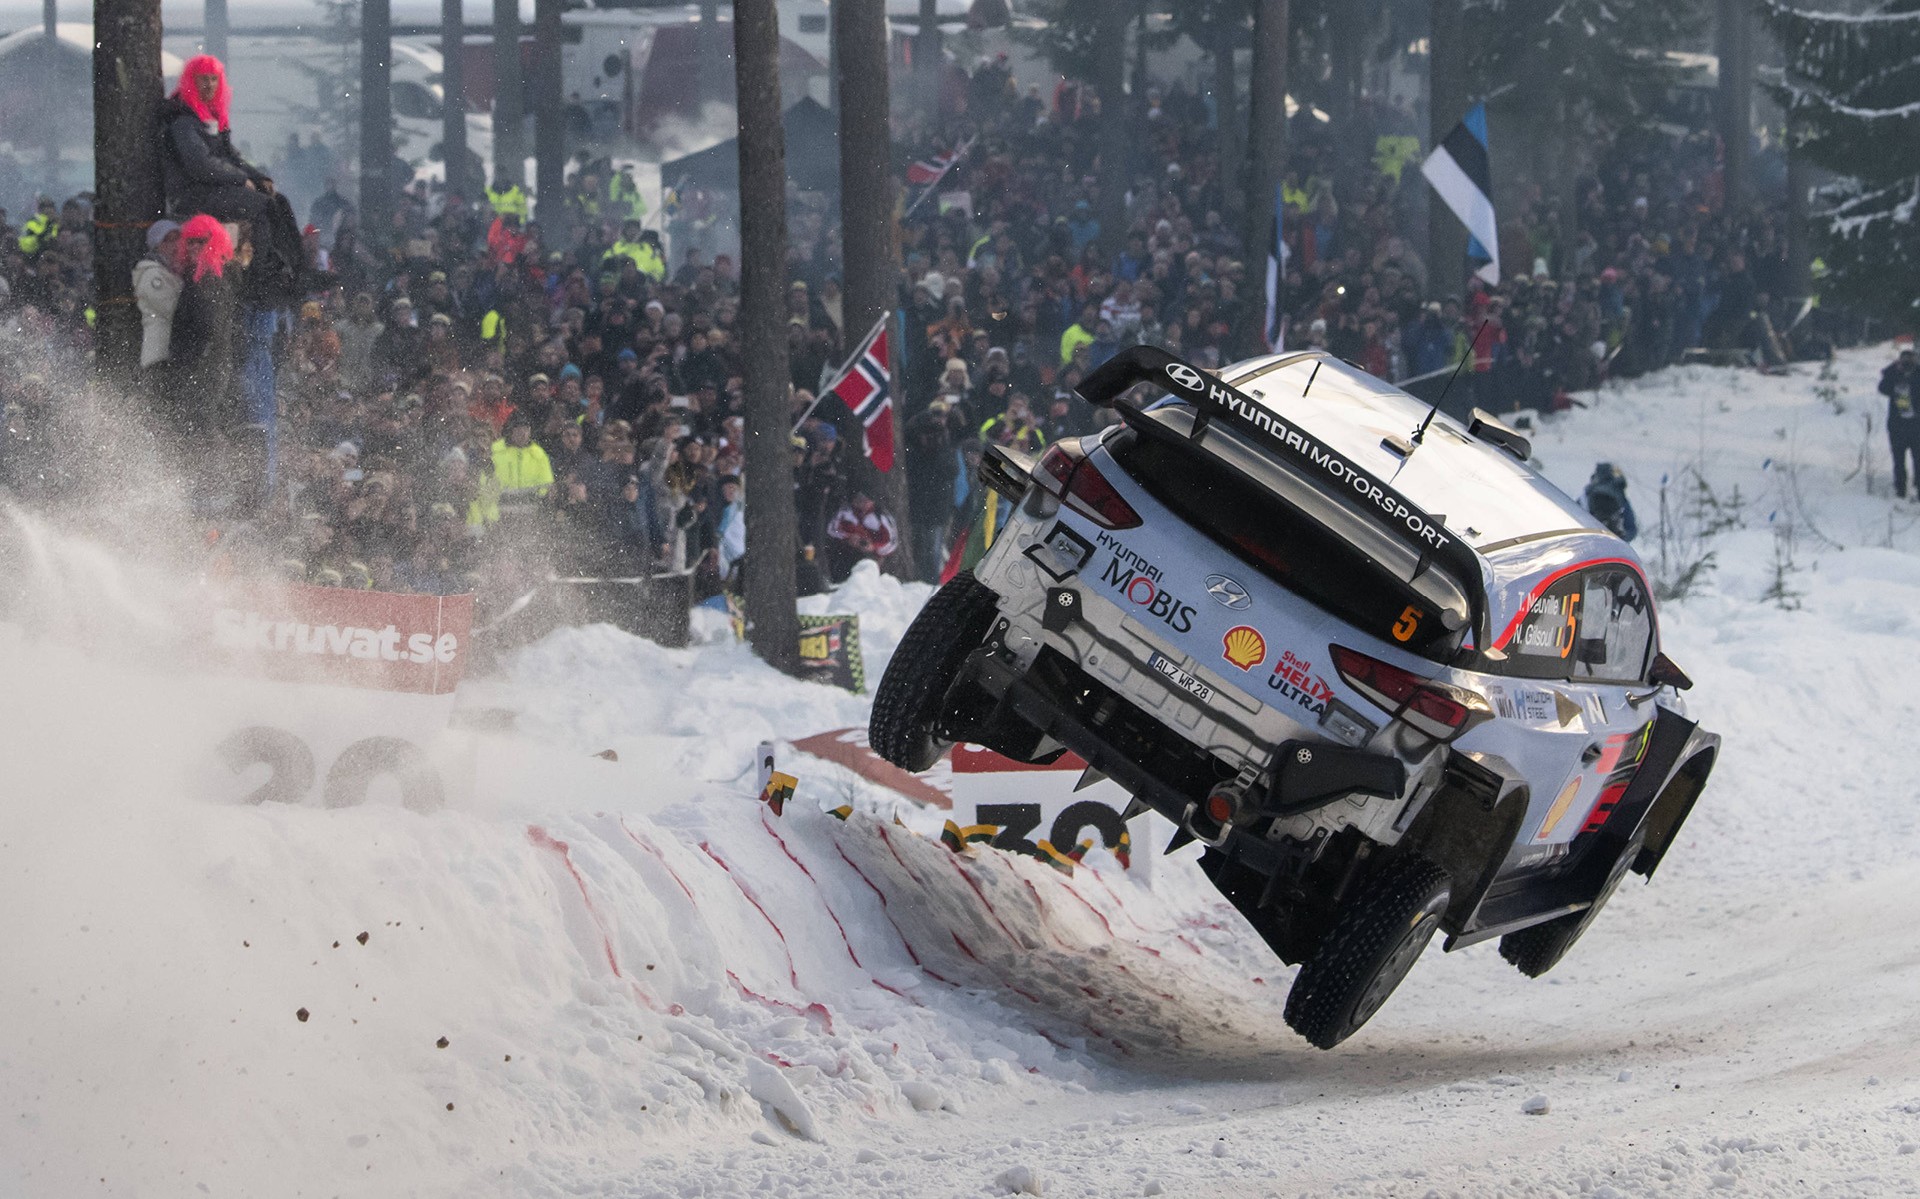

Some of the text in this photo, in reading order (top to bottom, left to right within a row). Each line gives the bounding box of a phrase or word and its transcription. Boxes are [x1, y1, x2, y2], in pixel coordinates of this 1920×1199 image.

[1209, 384, 1450, 550] HYUNDAI MOTORSPORT
[1096, 530, 1164, 583] HYUNDAI
[1101, 557, 1198, 633] MOBIS
[213, 608, 458, 664] Skruvat.se
[1391, 604, 1424, 642] 5
[1561, 593, 1580, 659] 5
[1154, 659, 1210, 700] ALZ WR 28
[1273, 661, 1337, 702] HELIX
[1281, 650, 1312, 673] Shell
[1268, 674, 1327, 718] ULTRA
